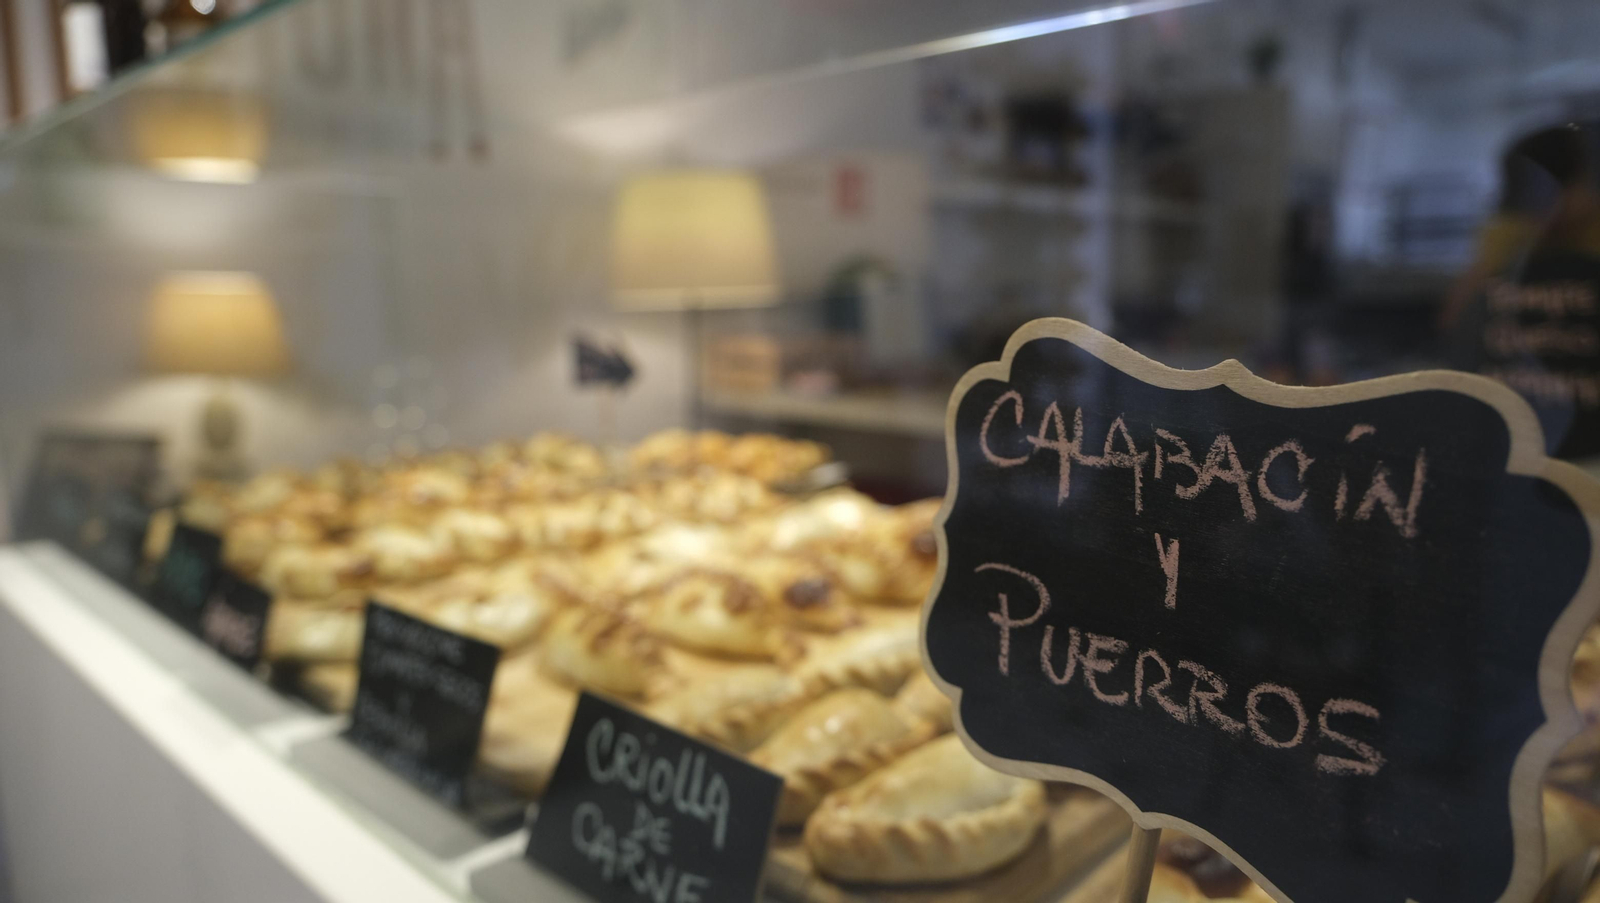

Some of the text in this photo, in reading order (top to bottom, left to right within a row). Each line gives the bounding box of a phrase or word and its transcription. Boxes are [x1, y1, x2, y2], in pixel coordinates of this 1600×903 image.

[974, 562, 1387, 776] PUERROS
[571, 801, 711, 903] CARNE
[632, 802, 671, 855] DE
